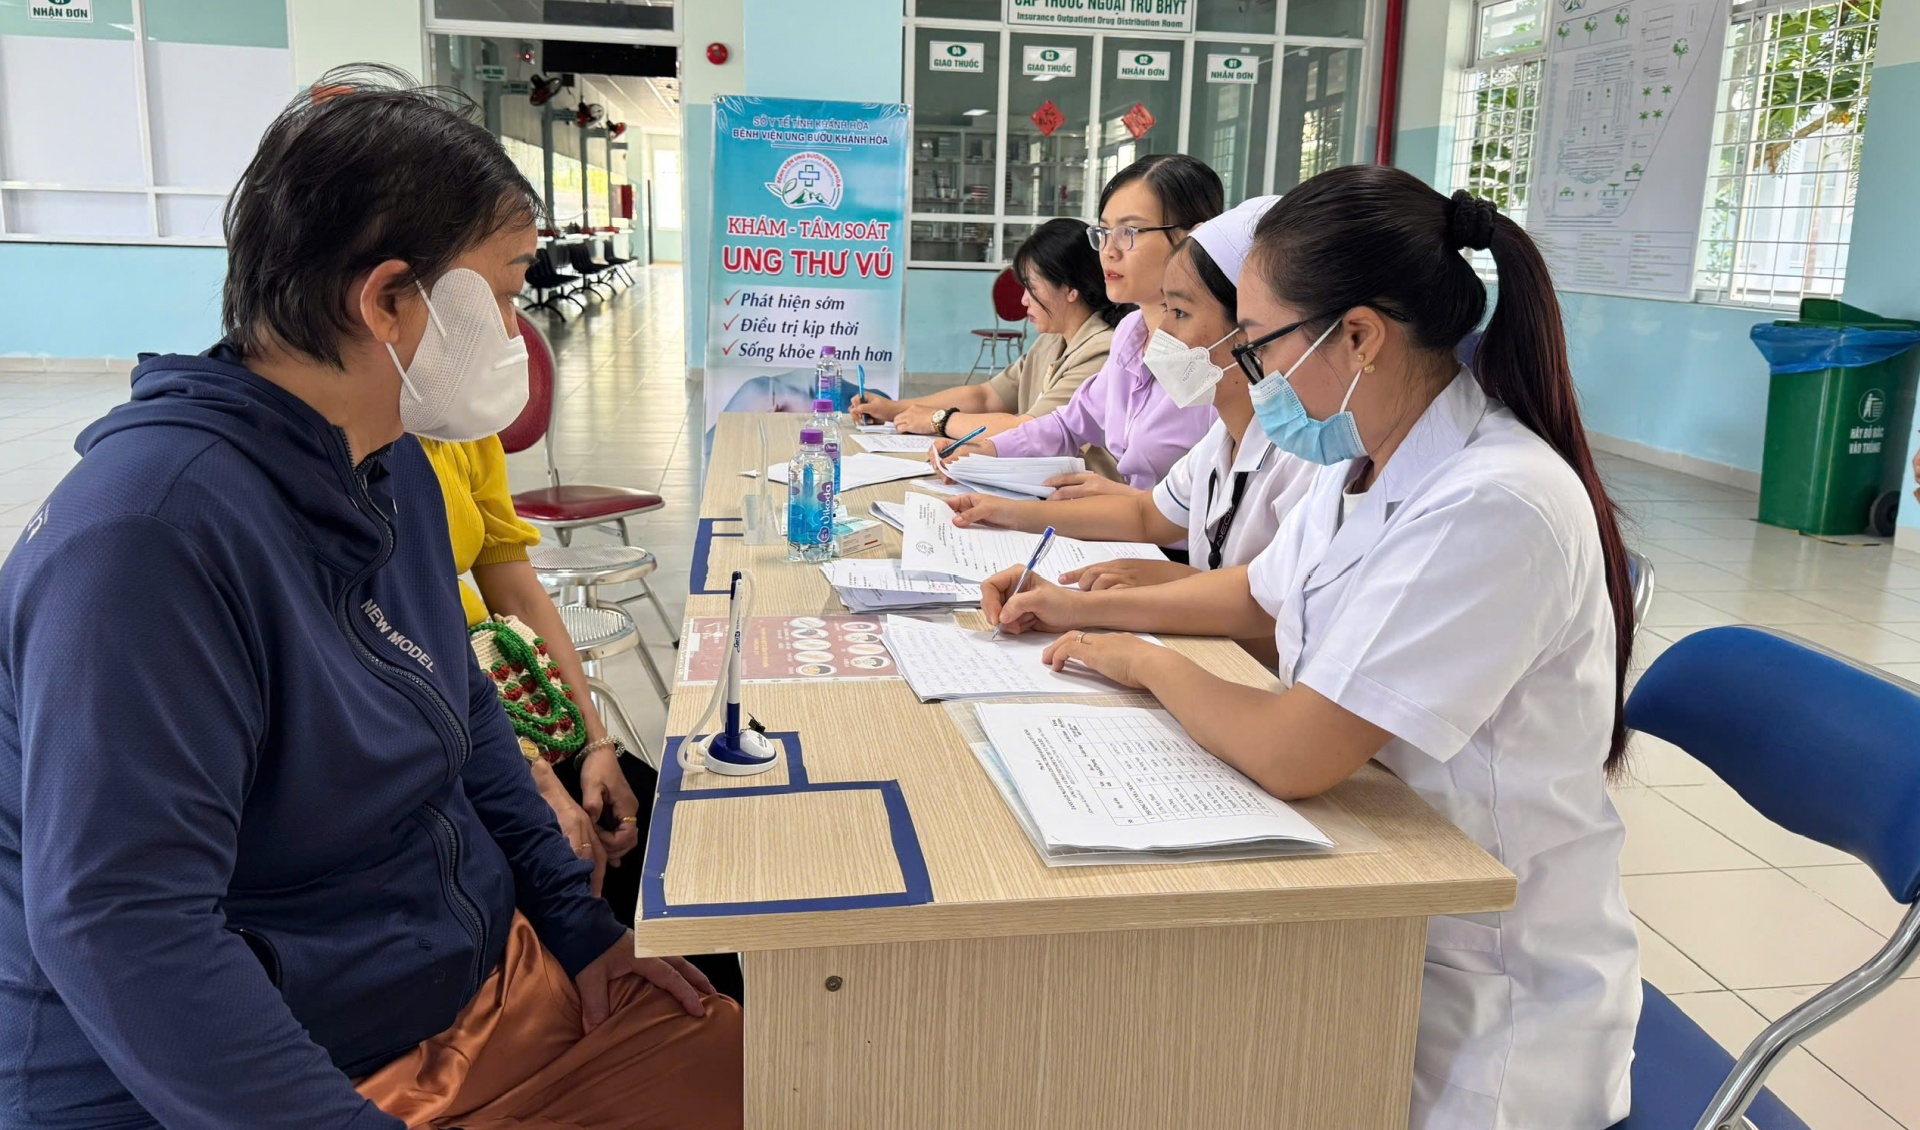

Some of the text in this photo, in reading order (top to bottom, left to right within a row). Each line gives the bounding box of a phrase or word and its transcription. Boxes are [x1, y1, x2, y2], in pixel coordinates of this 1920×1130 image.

[33, 6, 88, 19] NHẬN ĐƠN
[1156, 0, 1187, 15] BHYT
[1017, 12, 1183, 28] Insurance Outpatient Drug Distribution Room
[934, 57, 979, 68] GIAO THUỐC
[1047, 62, 1072, 72] THUỐC
[1139, 56, 1149, 64] 02
[1210, 70, 1254, 80] NHẬN ĐƠN
[769, 118, 775, 127] Y
[815, 117, 847, 130] KHÁNH
[849, 119, 869, 131] HÒA
[733, 128, 759, 140] BỆNH
[761, 129, 782, 142] VIỆN
[785, 132, 805, 142] UNG
[835, 132, 867, 144] KHÁNH
[869, 133, 888, 145] HÒA
[728, 216, 786, 236] KHÁM
[800, 217, 840, 238] TẦM
[844, 220, 889, 239] SOÁT
[723, 246, 892, 277] UNG THƯ VÚ
[741, 292, 845, 312] Phát hiện sớm
[741, 316, 860, 339] Điều trị kịp thời
[739, 341, 775, 362] Sống
[779, 343, 815, 359] khỏe
[865, 346, 893, 361] hơn
[820, 484, 831, 525] Vikoda
[360, 598, 434, 673] NEW MODEL
